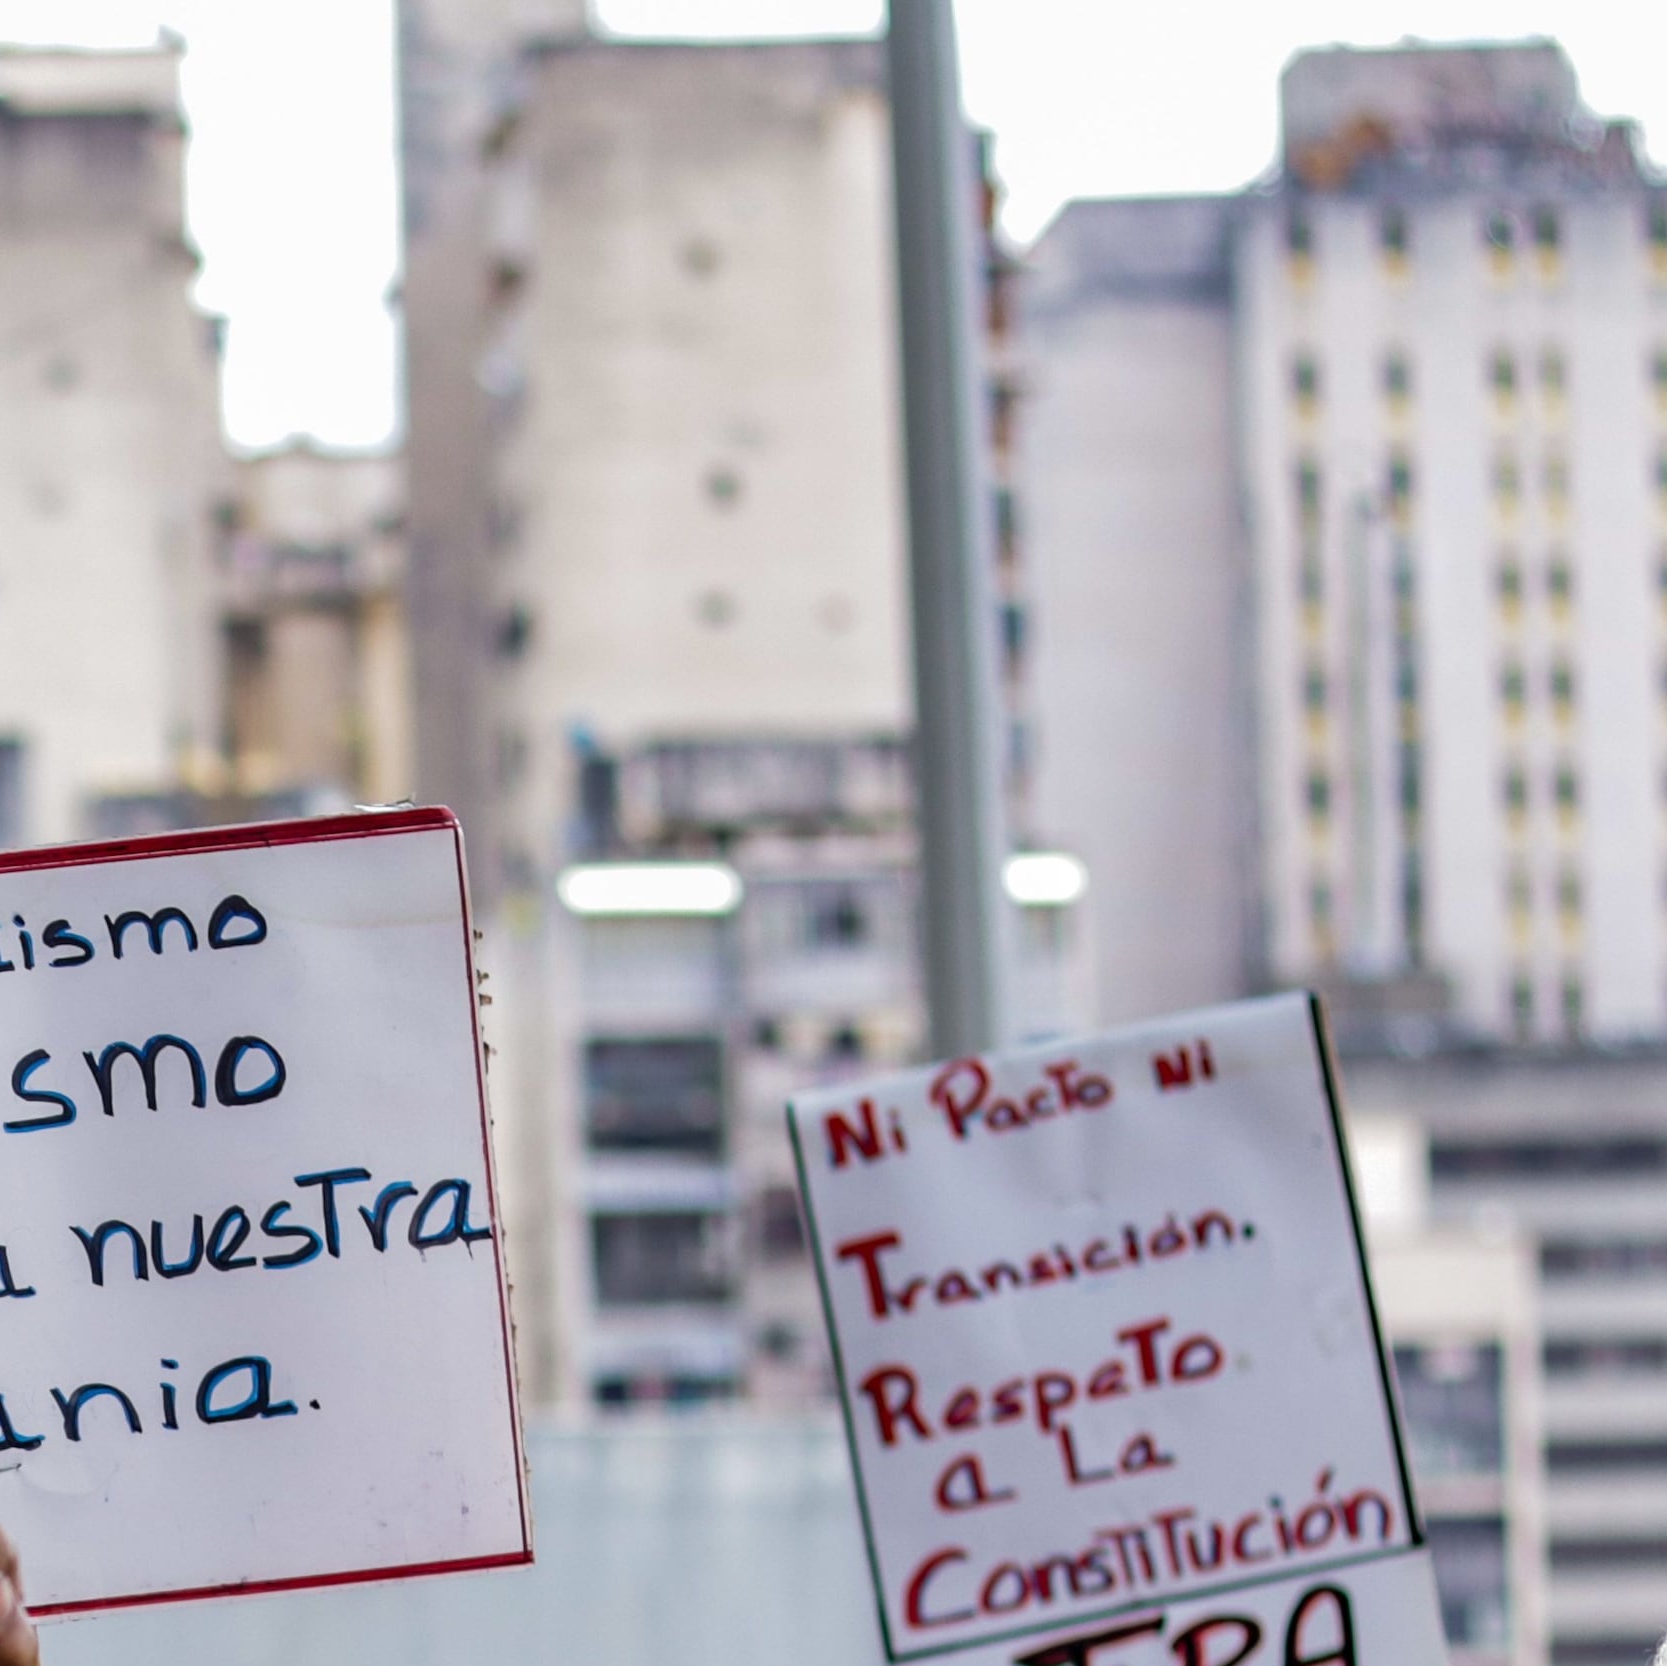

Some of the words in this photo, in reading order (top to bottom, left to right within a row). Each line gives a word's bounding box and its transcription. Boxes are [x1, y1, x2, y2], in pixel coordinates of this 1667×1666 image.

[825, 1097, 906, 1169] Ni
[1151, 1039, 1215, 1094] Ni
[935, 1454, 1016, 1513] a
